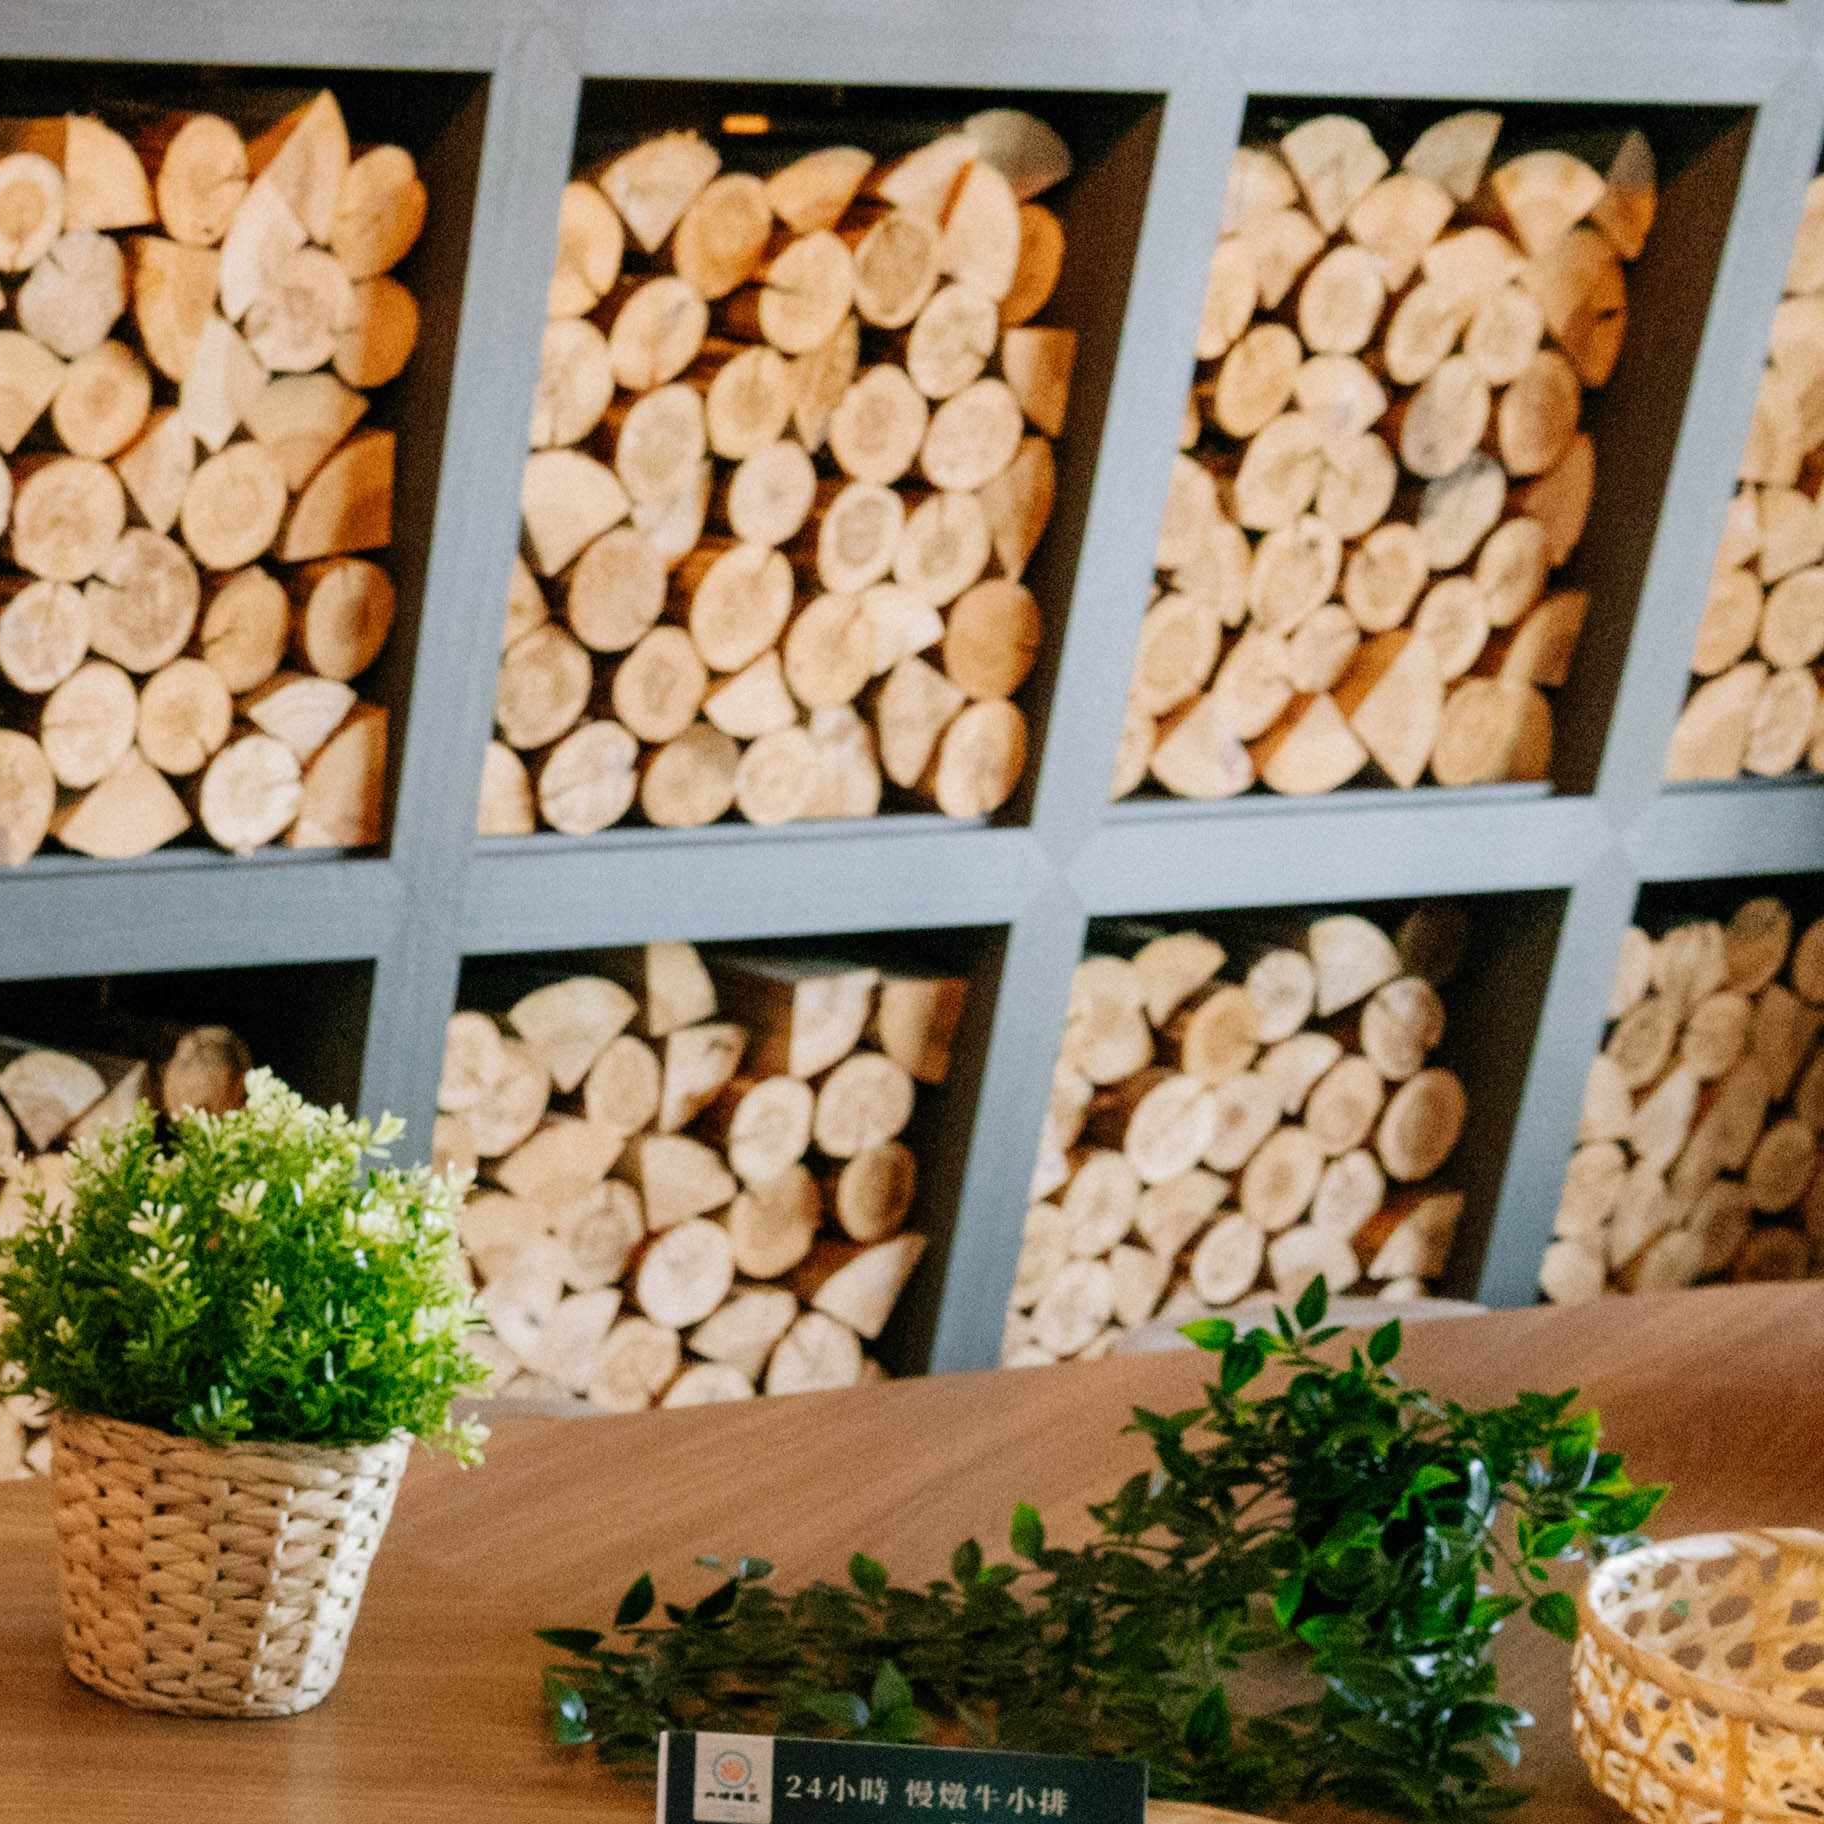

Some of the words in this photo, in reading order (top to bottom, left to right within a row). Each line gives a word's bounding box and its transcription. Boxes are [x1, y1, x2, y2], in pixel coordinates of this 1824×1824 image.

[785, 1774, 890, 1805] 24小時
[905, 1779, 1069, 1817] 慢燉牛小排
